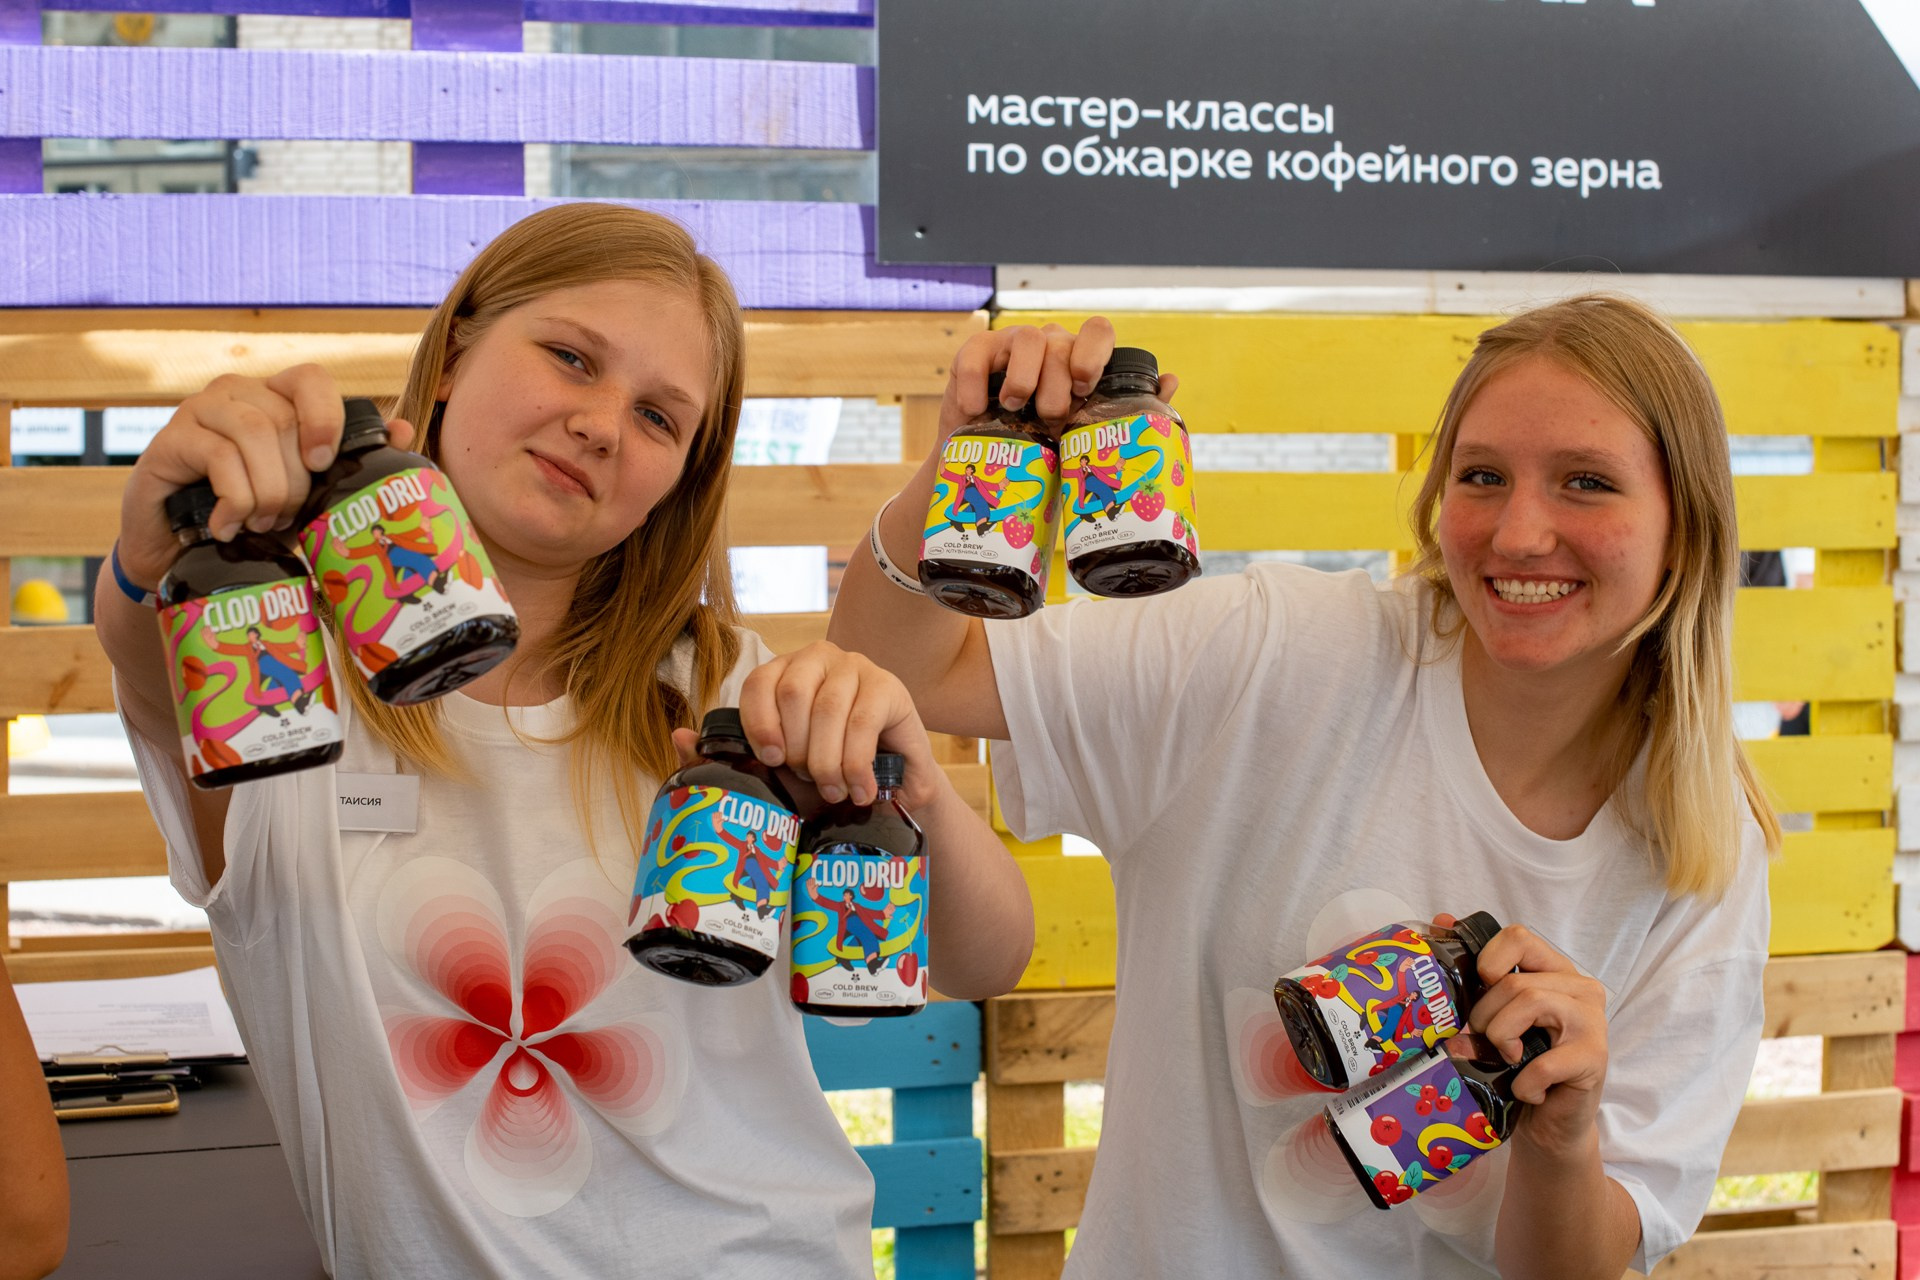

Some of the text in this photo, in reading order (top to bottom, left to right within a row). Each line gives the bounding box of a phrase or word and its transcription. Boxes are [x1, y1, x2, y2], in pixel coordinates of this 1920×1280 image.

[967, 94, 1334, 139] мастер-классы
[967, 134, 1663, 199] по обжарке кофейного зерна
[1095, 421, 1132, 451] DRU
[944, 440, 1024, 468] CLOD DRU
[327, 473, 428, 542] CLOD DRU
[1080, 528, 1119, 543] COLD BREW
[203, 583, 310, 634] CLOD DRU
[409, 615, 432, 632] COLD
[262, 731, 286, 743] COLD
[340, 796, 382, 806] ТАИСИЯ
[718, 796, 800, 847] CLOD DRU
[811, 859, 905, 889] CLOD DRU
[723, 918, 764, 937] COLD BREW
[833, 983, 879, 992] COLD BREW
[1411, 955, 1457, 1035] CLOD DRU
[1340, 1020, 1359, 1056] COLD BREW
